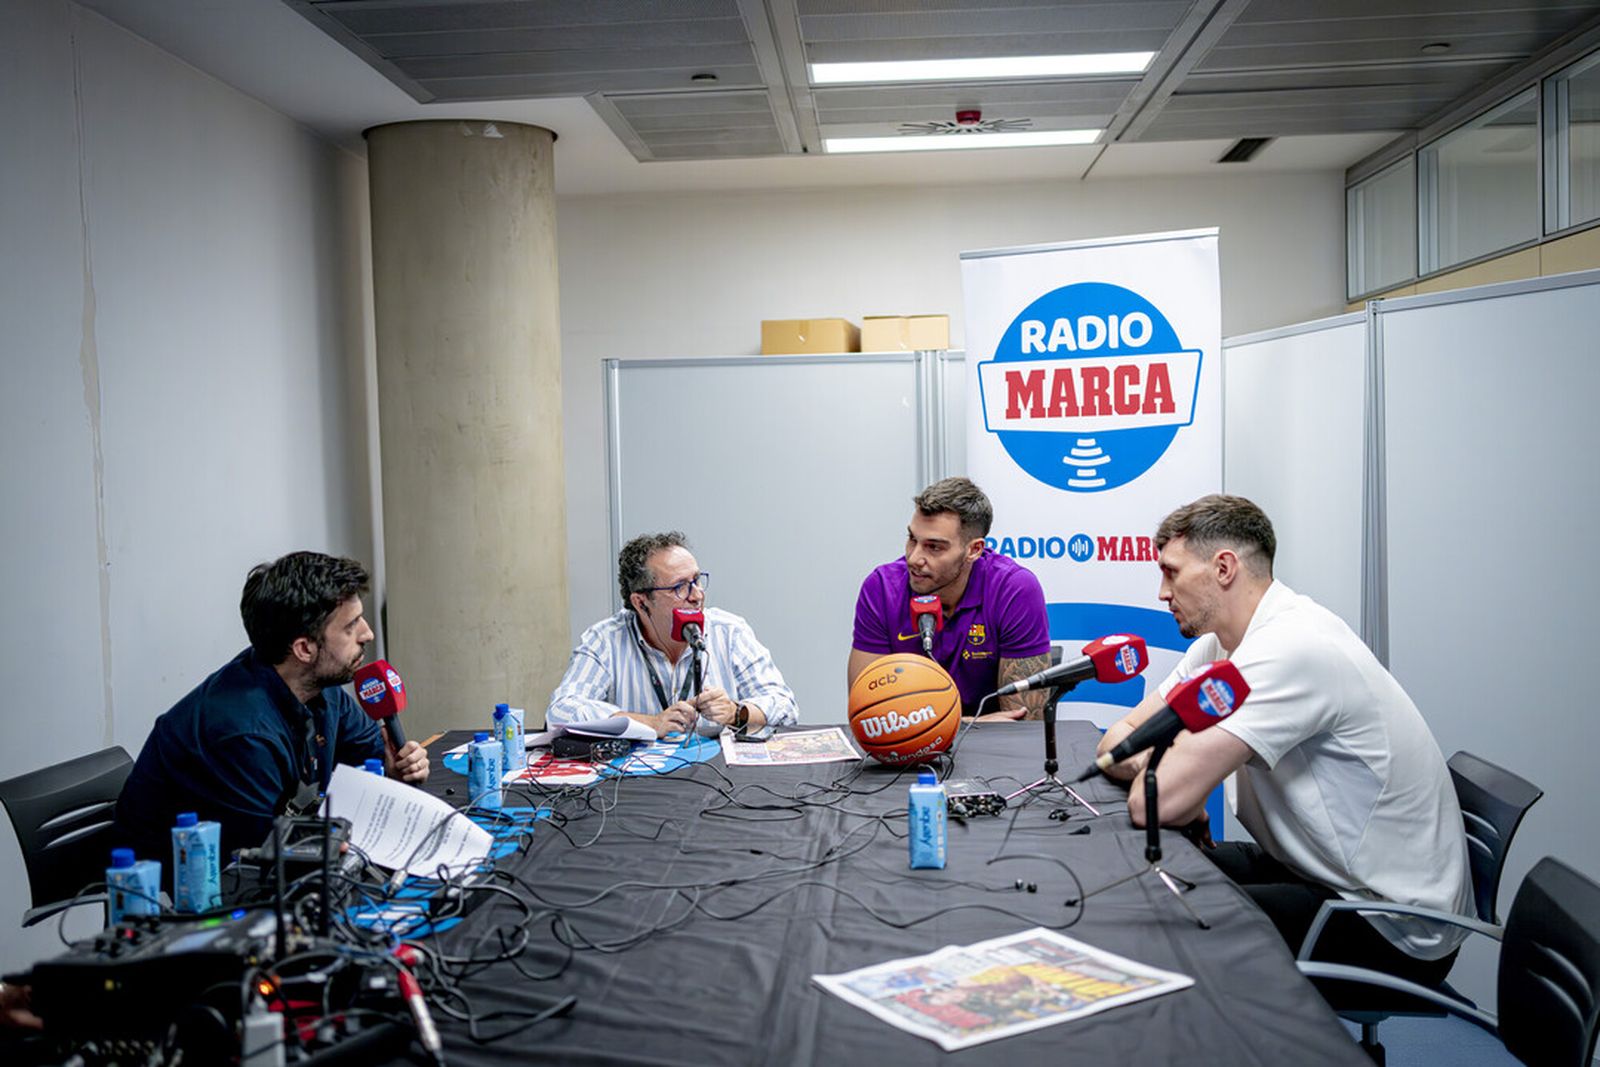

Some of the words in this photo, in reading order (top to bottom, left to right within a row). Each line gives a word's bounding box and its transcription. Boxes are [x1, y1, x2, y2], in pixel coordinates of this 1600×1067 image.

[1020, 311, 1153, 354] RADIO
[1005, 362, 1176, 420] MARCA
[1096, 536, 1159, 562] MAR
[868, 674, 898, 691] acb
[860, 704, 937, 739] Wilson
